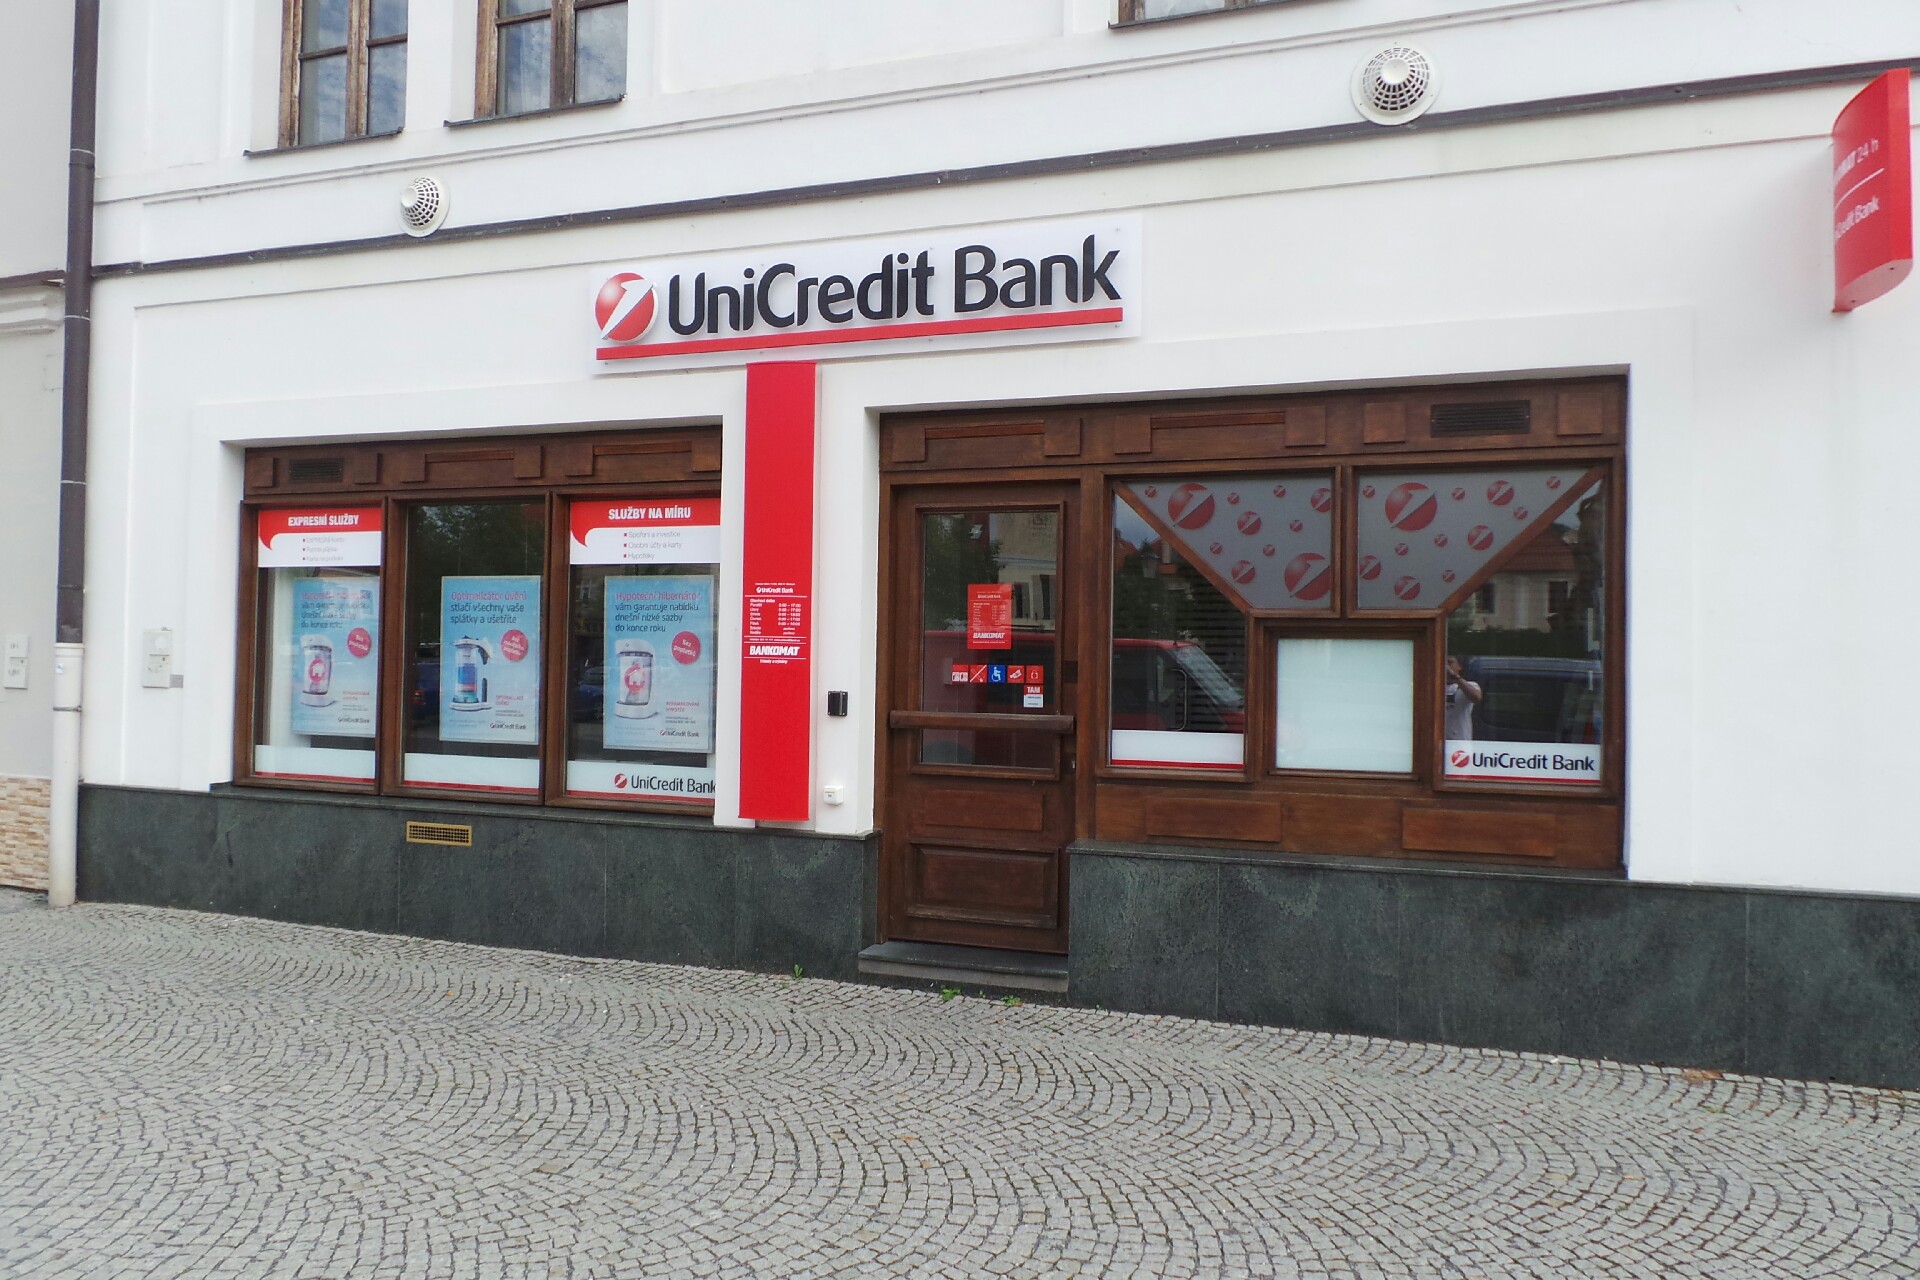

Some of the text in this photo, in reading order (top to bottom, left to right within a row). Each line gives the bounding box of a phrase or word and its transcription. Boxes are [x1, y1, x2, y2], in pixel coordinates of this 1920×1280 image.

[668, 234, 1122, 335] UniCredit Bank
[608, 505, 691, 520] SLUŽBY NA MÍRU
[288, 513, 359, 527] EXPRESNÍ SLUŽBY
[450, 603, 525, 614] stlačí všechny vaše
[615, 602, 699, 613] vám garantuje nabídku
[450, 615, 478, 625] splátky
[615, 613, 683, 623] dnešní nízké sazby
[615, 624, 666, 632] do konce roku
[749, 645, 801, 656] BANKOMAT
[1472, 752, 1595, 772] UniCredit Bank
[631, 775, 715, 793] UniCredit Bank
